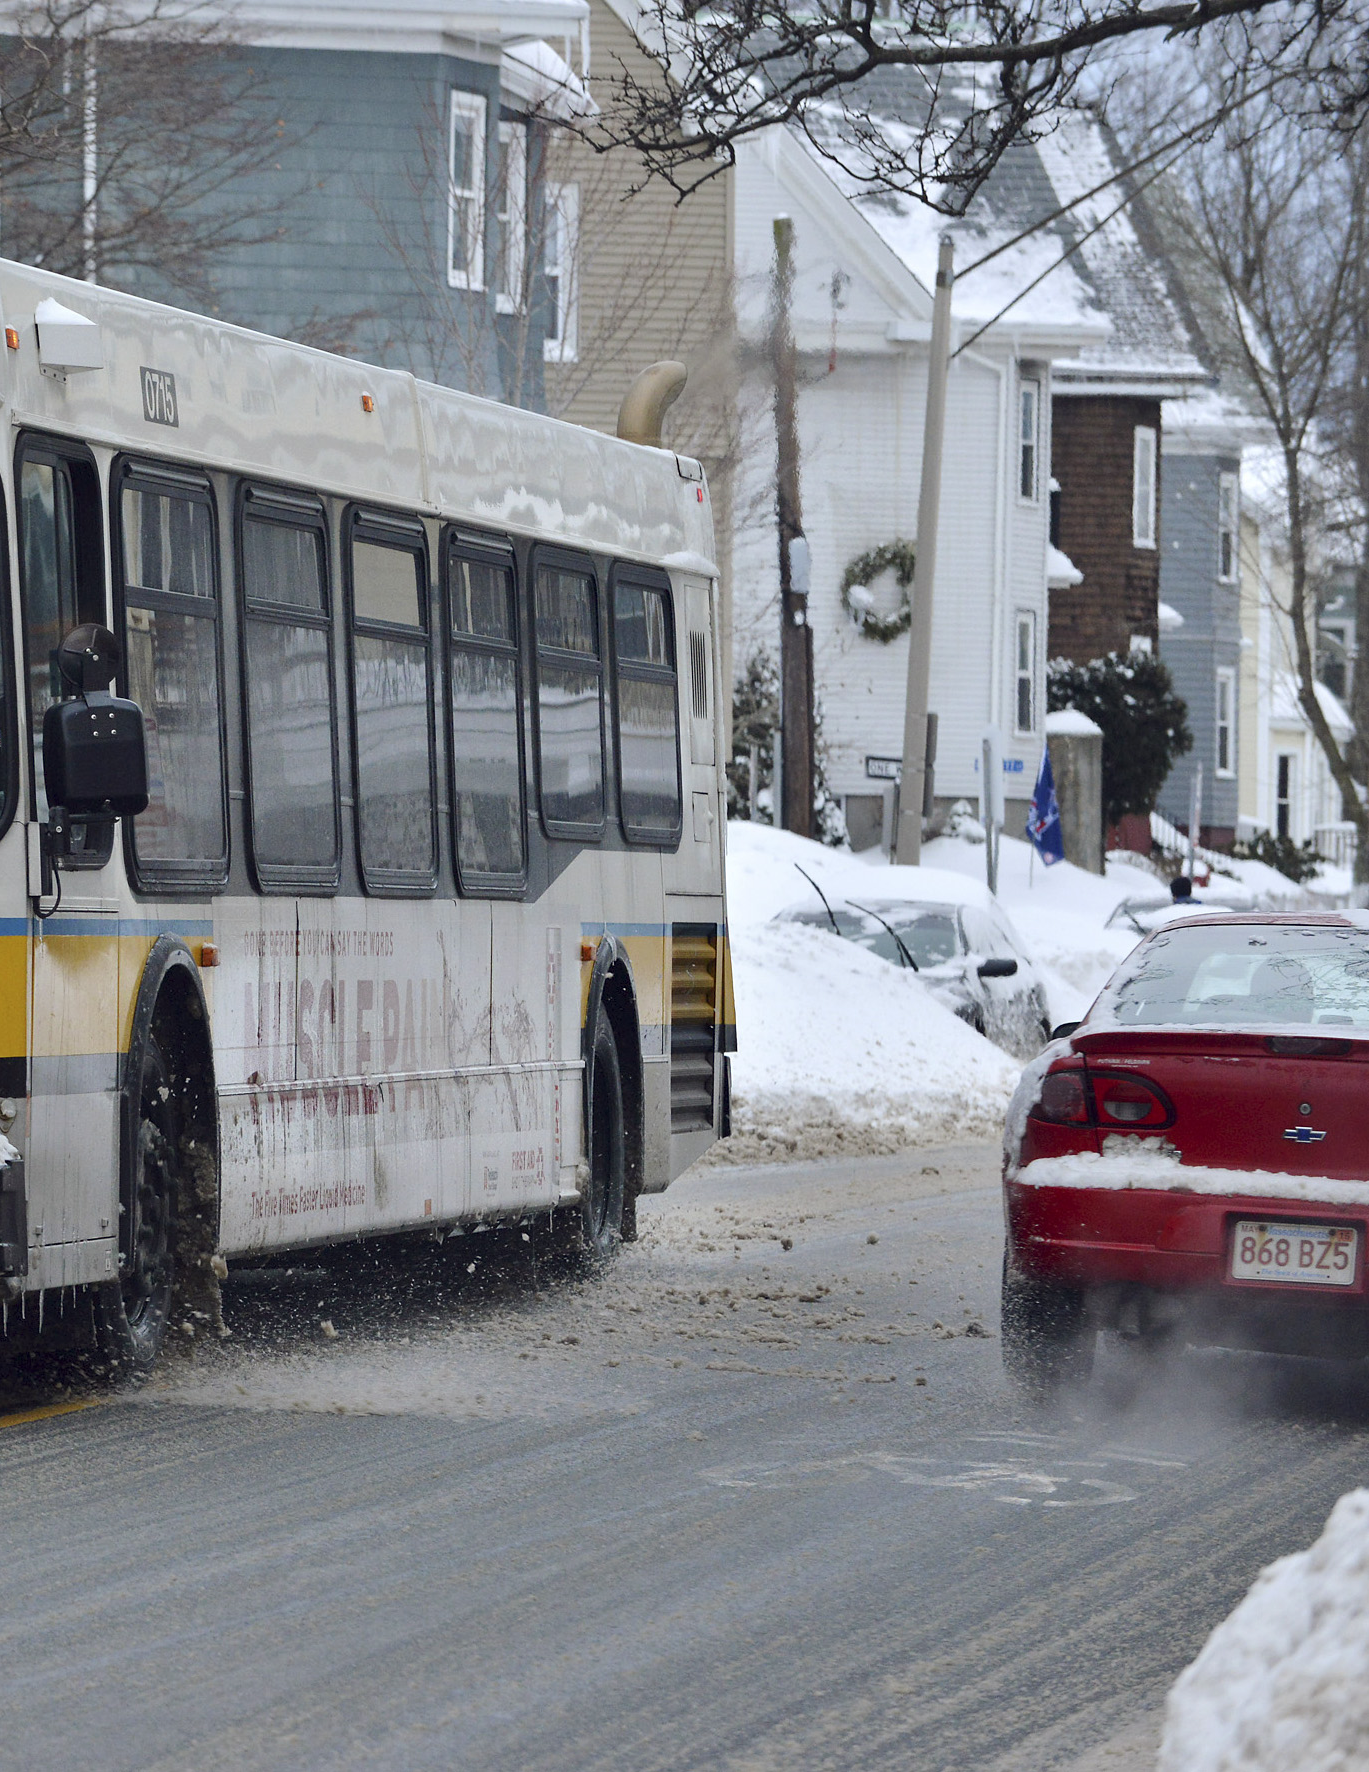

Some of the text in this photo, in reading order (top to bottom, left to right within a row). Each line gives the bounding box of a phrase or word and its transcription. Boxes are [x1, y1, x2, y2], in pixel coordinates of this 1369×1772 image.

[145, 371, 174, 423] 0715
[269, 930, 301, 957] BEFORE
[337, 930, 351, 957] SAY
[353, 930, 367, 957] THE
[369, 930, 394, 957] WORDS
[244, 978, 378, 1120] MUSCLE
[251, 1191, 263, 1219] The
[278, 1188, 298, 1215] Times
[300, 1186, 319, 1213] Faster
[339, 1181, 366, 1207] Medicine
[1241, 1225, 1260, 1233] MAY
[1240, 1236, 1350, 1270] 868 BZ5
